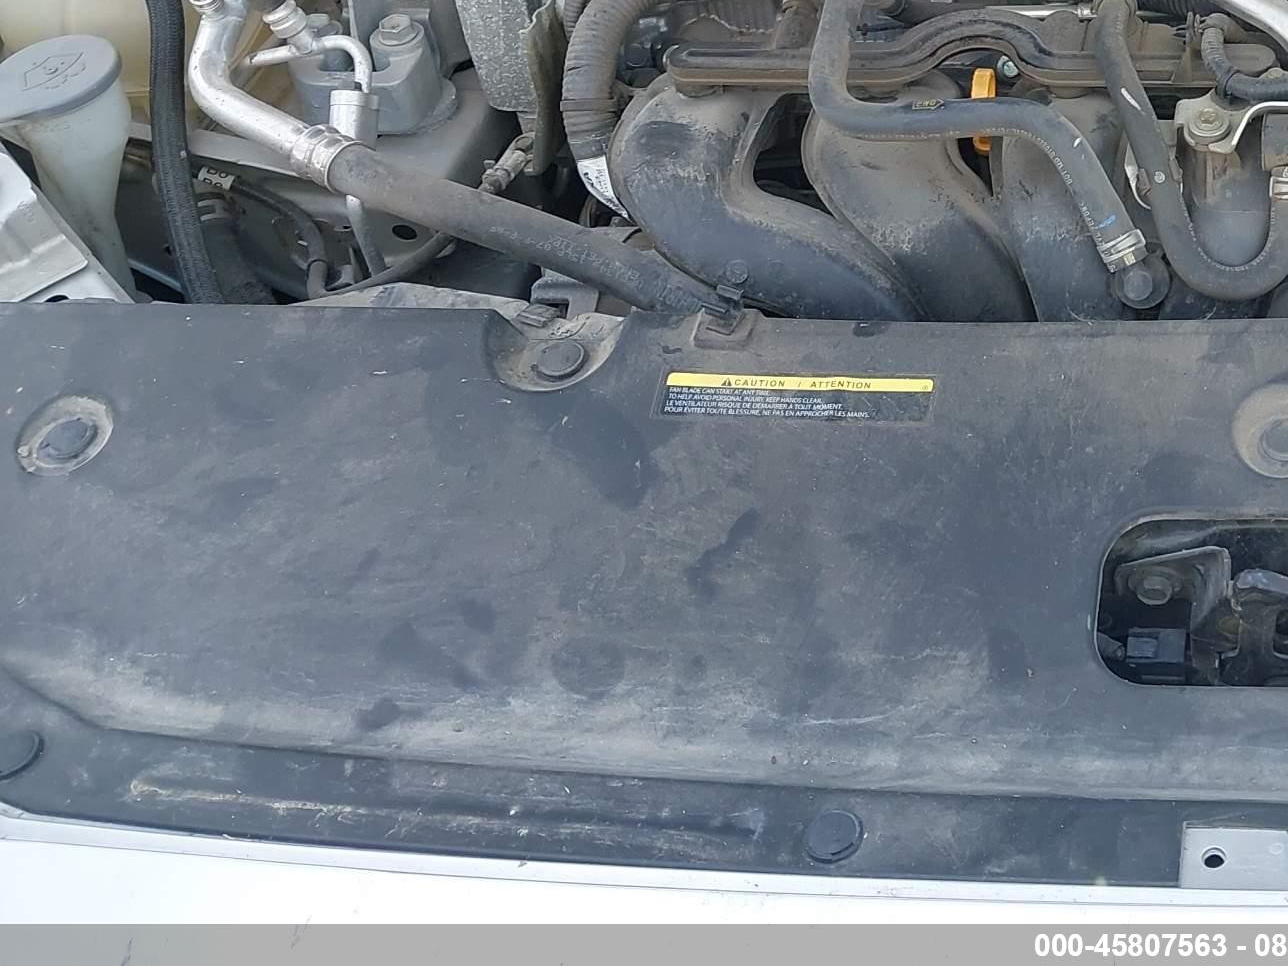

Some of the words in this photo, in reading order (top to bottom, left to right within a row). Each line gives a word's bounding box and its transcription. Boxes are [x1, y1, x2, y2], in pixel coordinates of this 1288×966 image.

[734, 378, 785, 388] CAUTION
[809, 379, 872, 390] ATTENTION
[675, 400, 718, 408] VENTILATEUR
